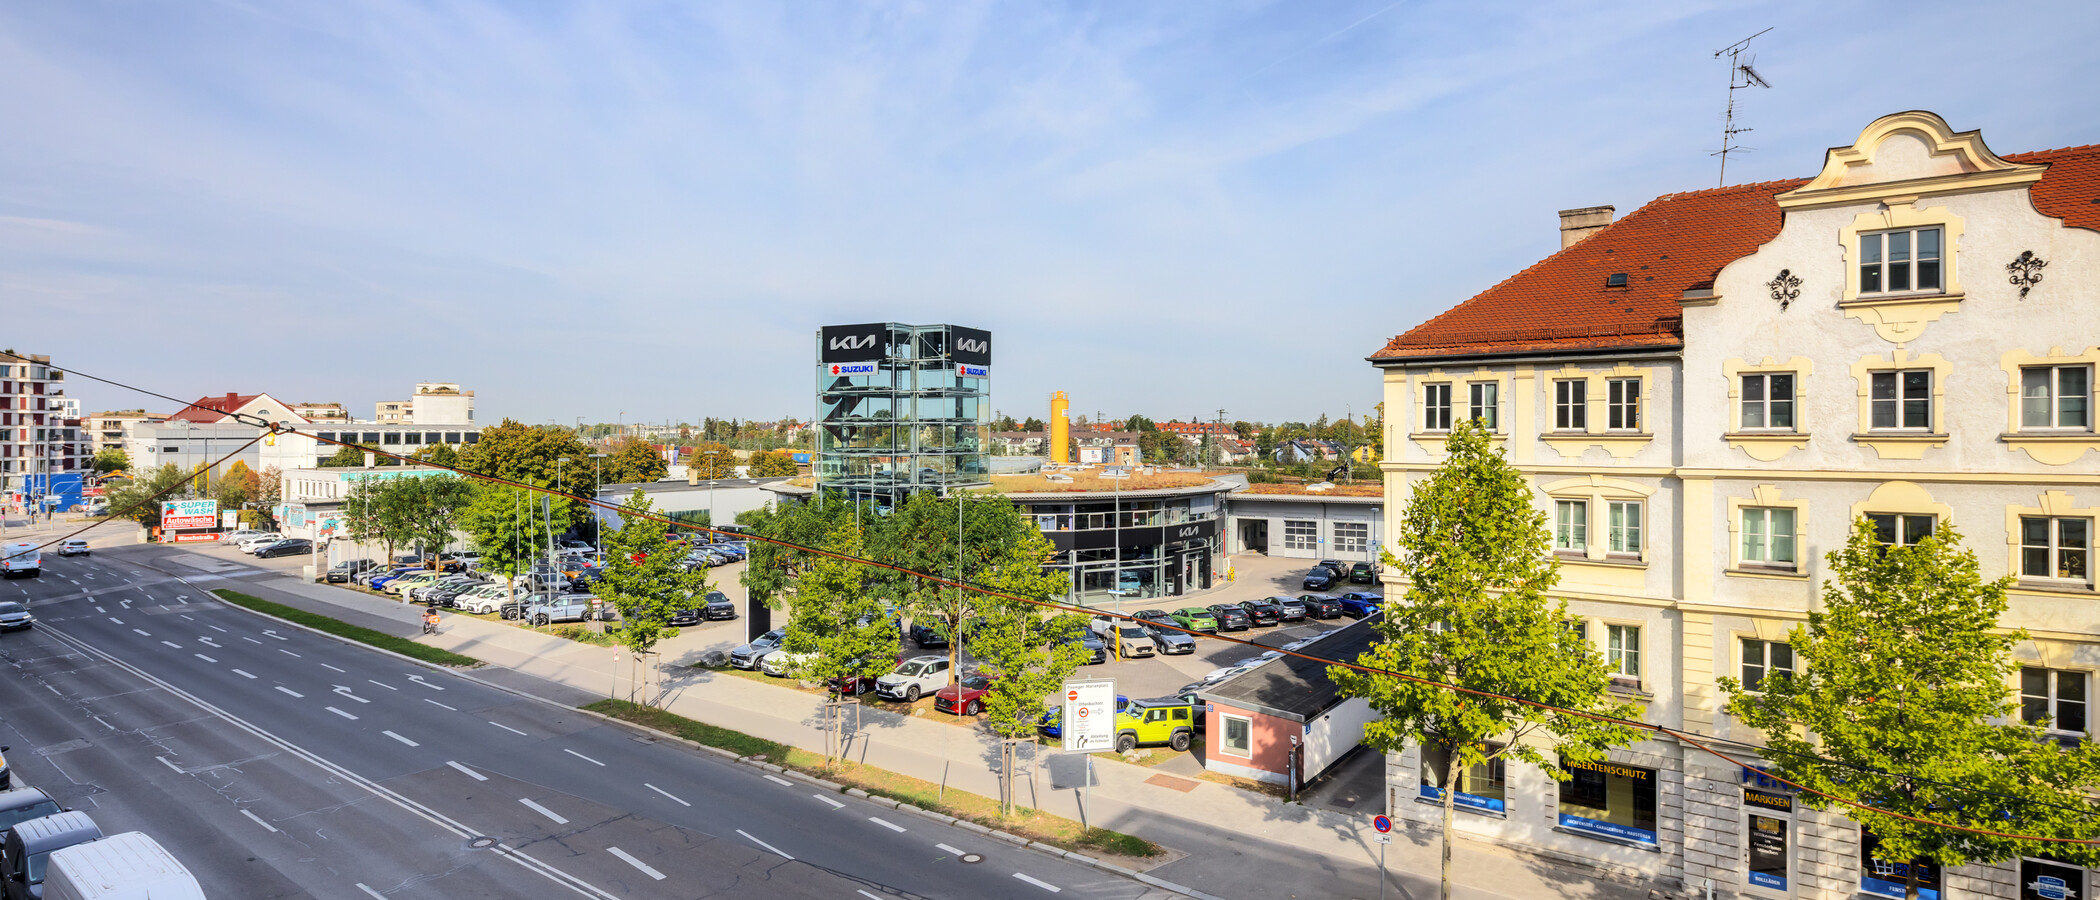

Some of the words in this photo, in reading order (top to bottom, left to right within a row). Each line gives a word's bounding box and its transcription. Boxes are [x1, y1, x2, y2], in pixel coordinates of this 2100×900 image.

[841, 365, 873, 374] SUZUKI
[966, 367, 987, 376] SUZUKI
[180, 501, 215, 509] SUPER
[184, 507, 214, 515] WASH
[166, 516, 213, 524] Autowäsche
[1567, 761, 1647, 780] INSEKTENSCHUTZ
[1745, 792, 1790, 808] MARKISEN
